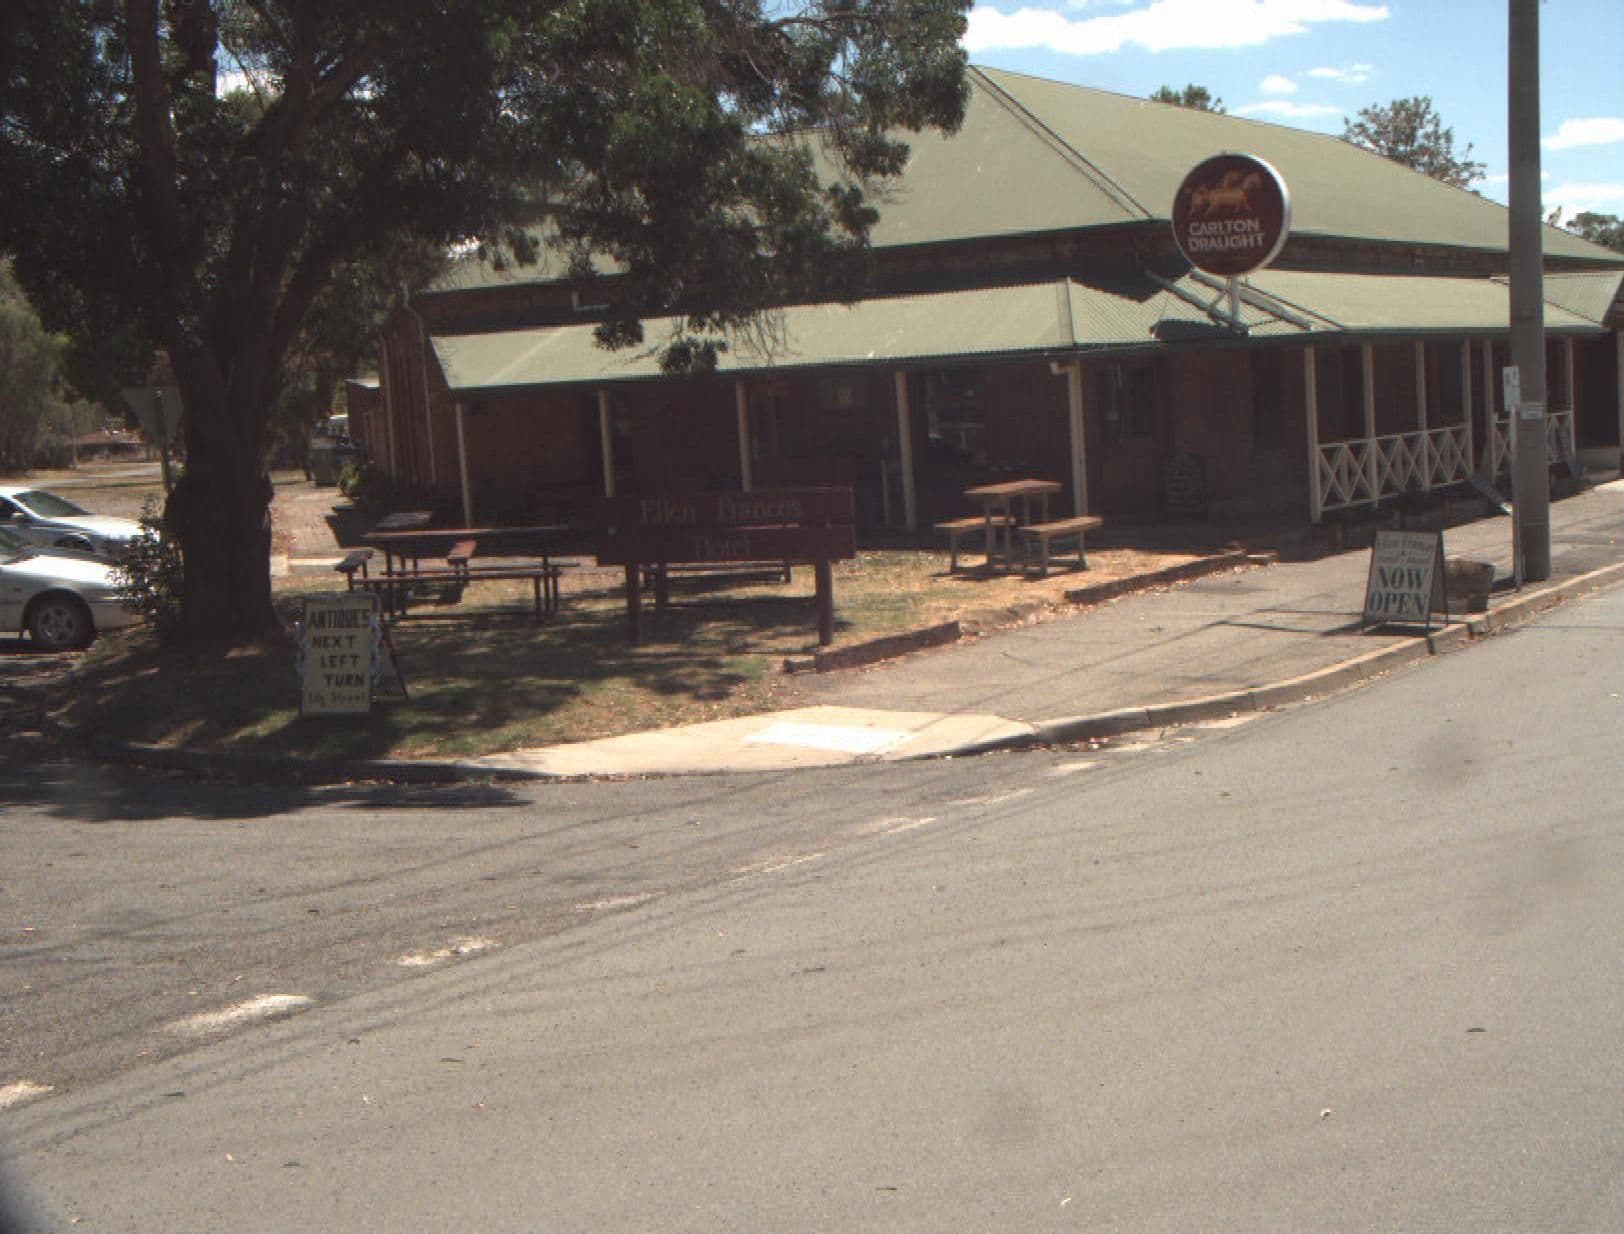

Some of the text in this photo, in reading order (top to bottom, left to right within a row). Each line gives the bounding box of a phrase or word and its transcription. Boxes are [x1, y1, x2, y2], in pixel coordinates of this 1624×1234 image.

[1189, 218, 1260, 236] CARLTON
[1187, 232, 1265, 252] DRAUGHT
[639, 498, 696, 523] Ellen
[1373, 566, 1429, 589] NOW
[1368, 592, 1429, 616] OPEN
[308, 608, 371, 629] ANTIQUES
[311, 635, 357, 649] NEXT
[320, 655, 360, 669] LEFT
[323, 673, 365, 687] TURN
